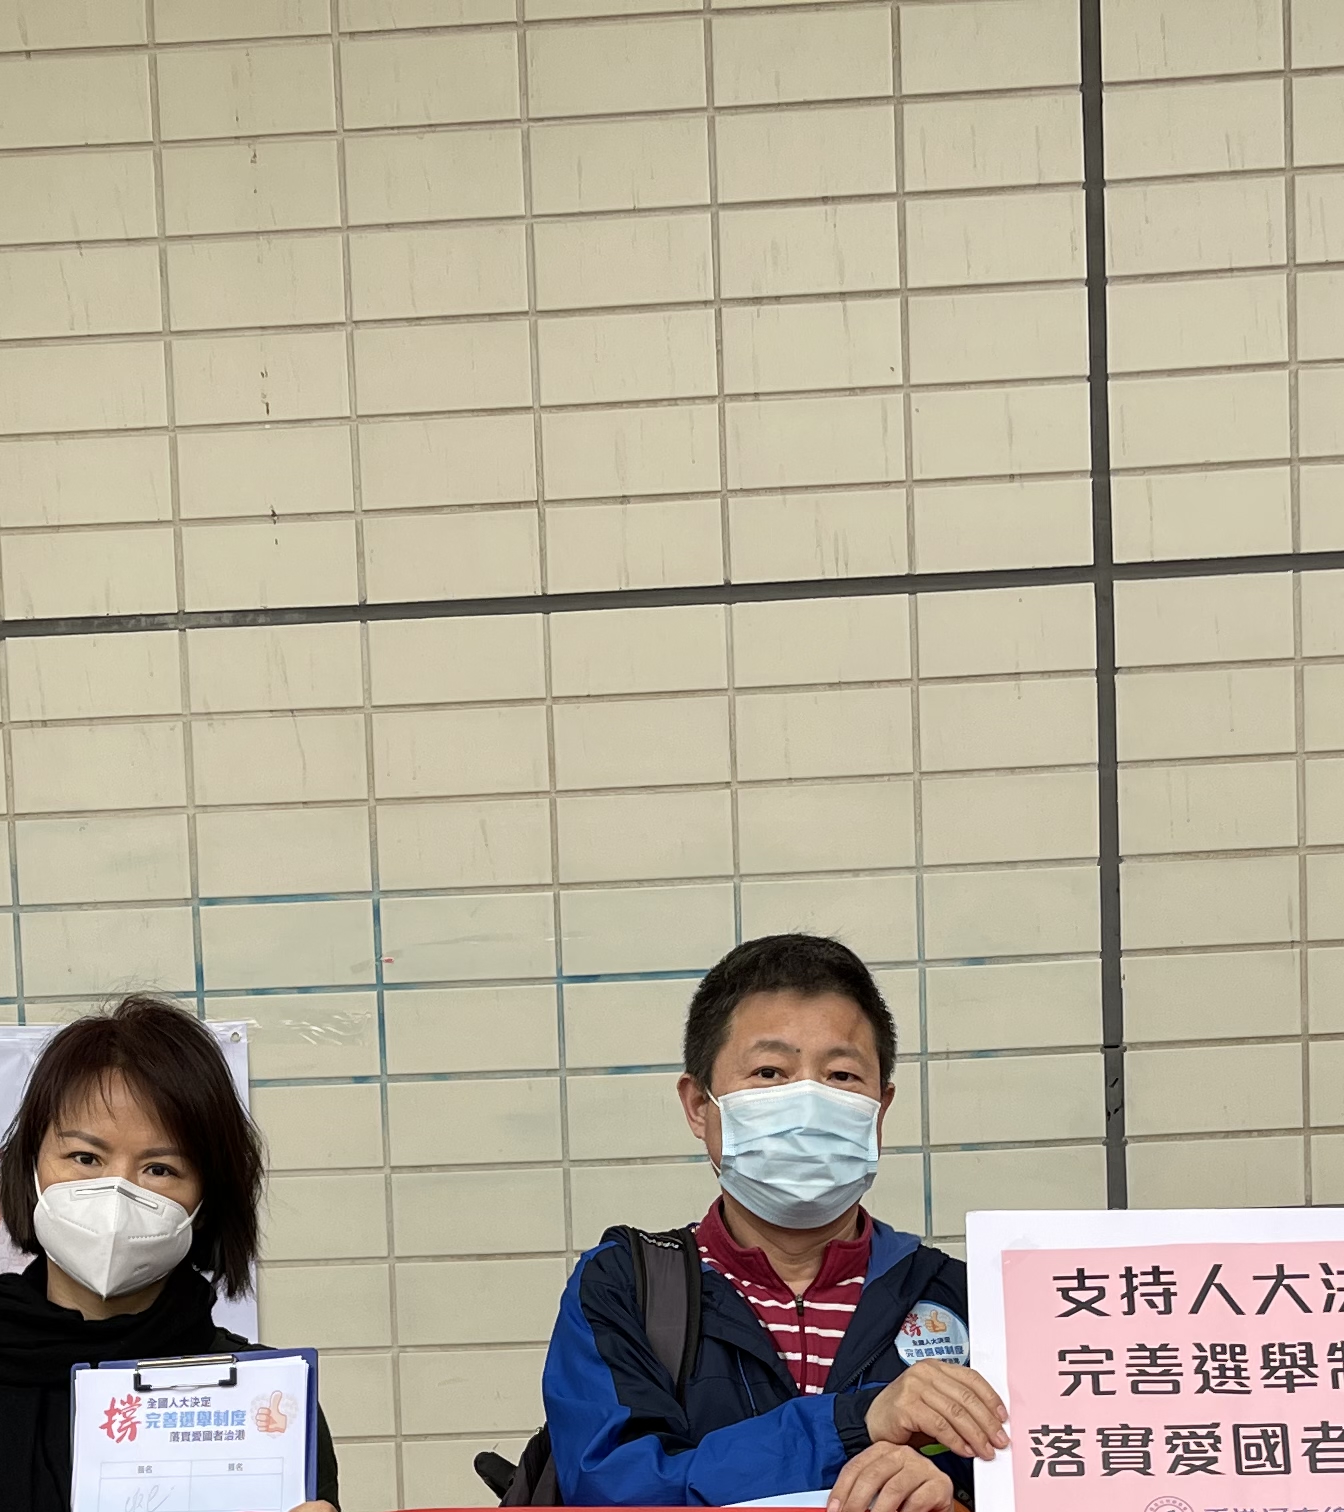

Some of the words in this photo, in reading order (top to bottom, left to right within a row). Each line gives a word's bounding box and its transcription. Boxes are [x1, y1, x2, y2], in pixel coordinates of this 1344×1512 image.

[147, 1396, 211, 1409] 全國人大決定
[145, 1410, 247, 1429] 完善選舉制度
